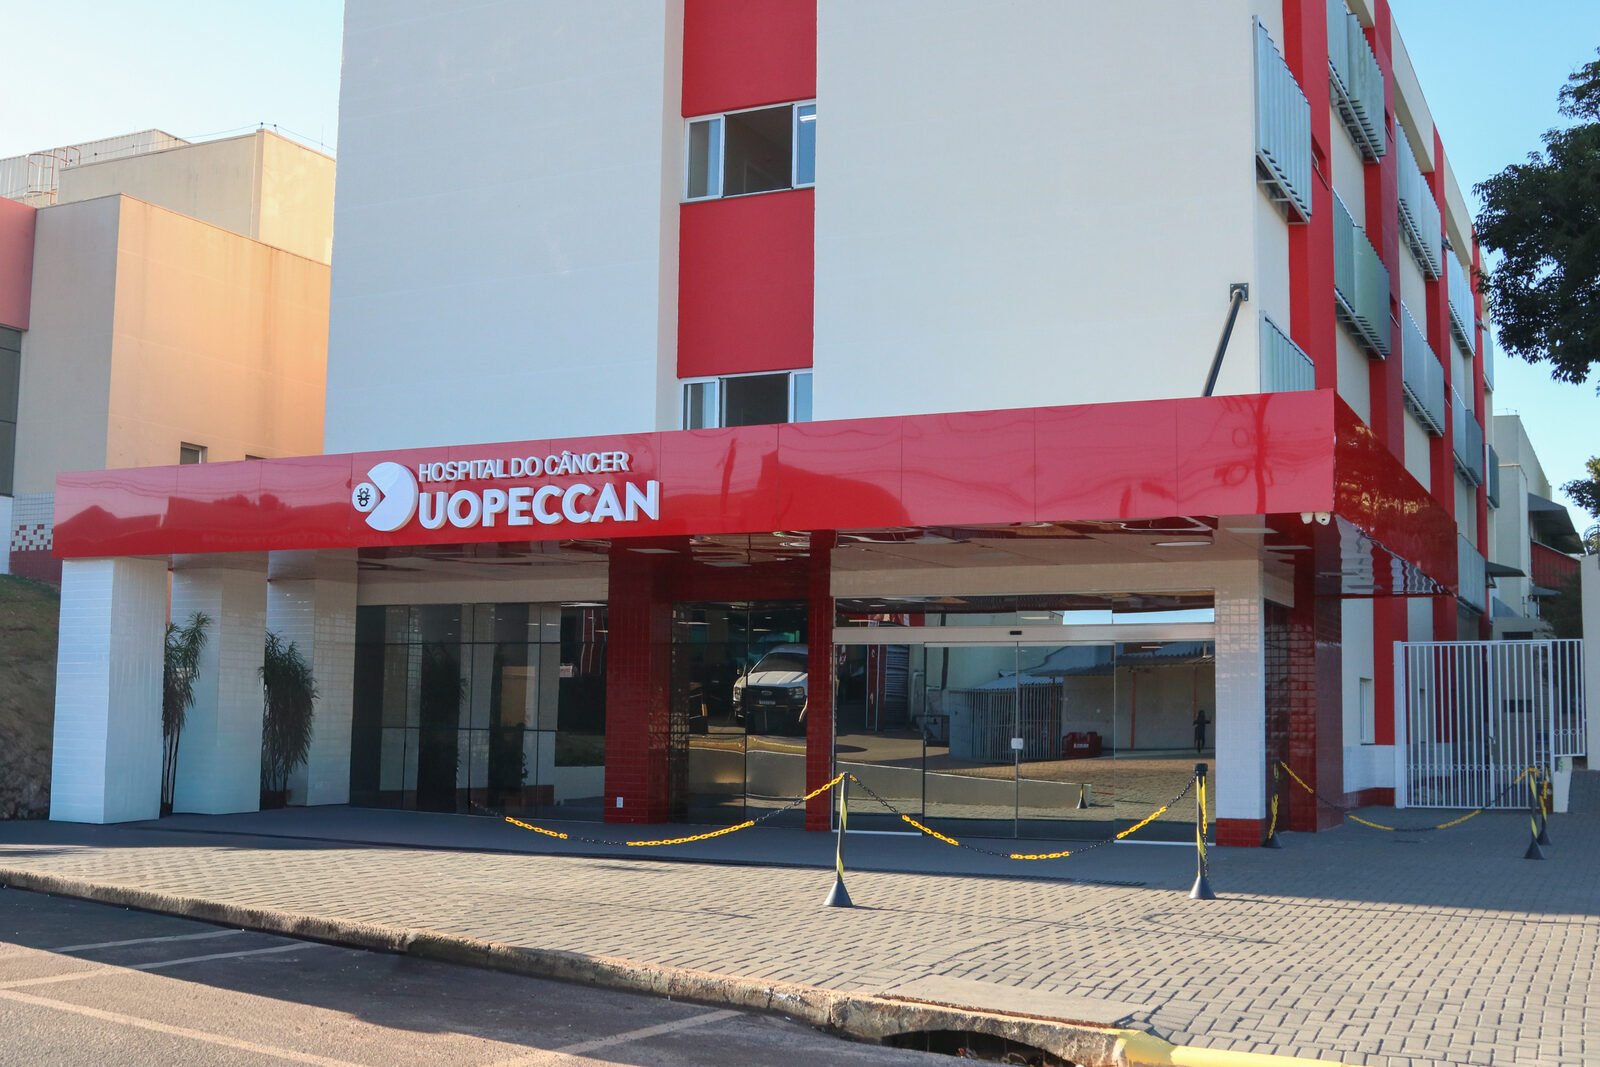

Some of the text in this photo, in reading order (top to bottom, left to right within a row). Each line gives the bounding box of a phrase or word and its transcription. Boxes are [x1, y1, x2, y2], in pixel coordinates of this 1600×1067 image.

[418, 450, 629, 482] HOSPITAL DO CÂNCER
[418, 480, 660, 530] UOPECCAN
